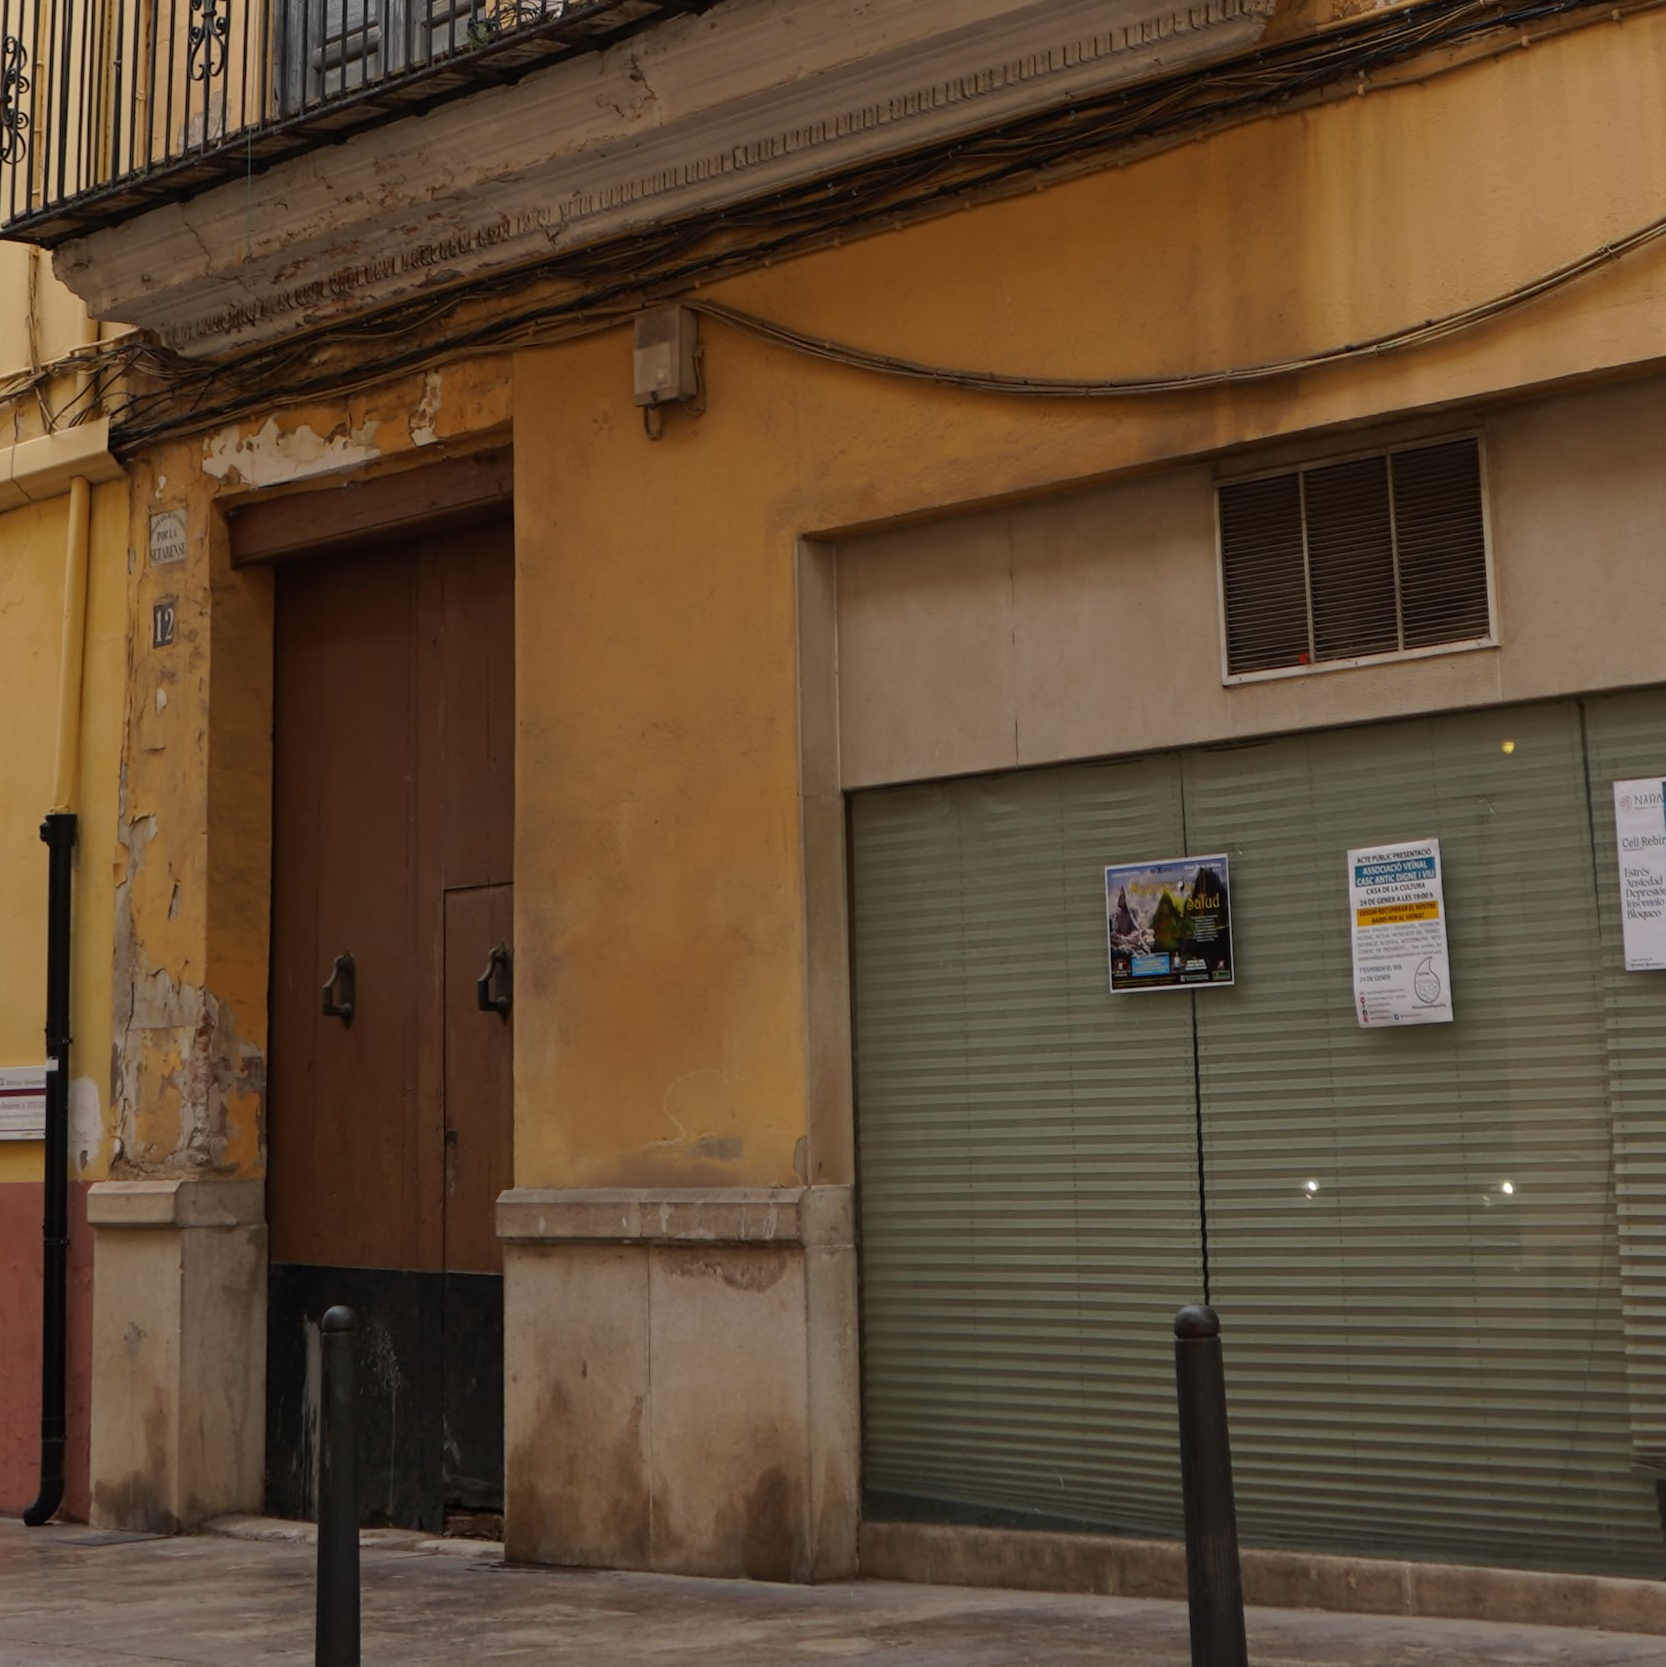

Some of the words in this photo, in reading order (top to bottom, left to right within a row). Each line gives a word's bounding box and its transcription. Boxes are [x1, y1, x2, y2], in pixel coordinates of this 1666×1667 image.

[156, 607, 174, 642] 12
[1622, 837, 1640, 848] Cell
[1357, 856, 1371, 864] ACTE
[1393, 848, 1432, 859] PRESENTACIÓ
[1363, 862, 1402, 875] ASSOCIACIÓ
[1356, 876, 1374, 887] CASC
[1374, 873, 1395, 885] ANTIC
[1396, 871, 1417, 882] DIGNE
[1627, 875, 1663, 887] Ansiedad
[1366, 887, 1381, 895] CASA
[1382, 886, 1390, 894] DE
[1391, 885, 1399, 893] LA
[1399, 882, 1426, 892] CULTURA
[1186, 893, 1220, 911] Salud
[1360, 899, 1367, 907] 24
[1367, 898, 1376, 906] DE
[1376, 896, 1396, 904] GENER
[1401, 894, 1412, 902] LES
[1626, 897, 1665, 908] Insomnio
[1627, 909, 1662, 921] Bloqueo
